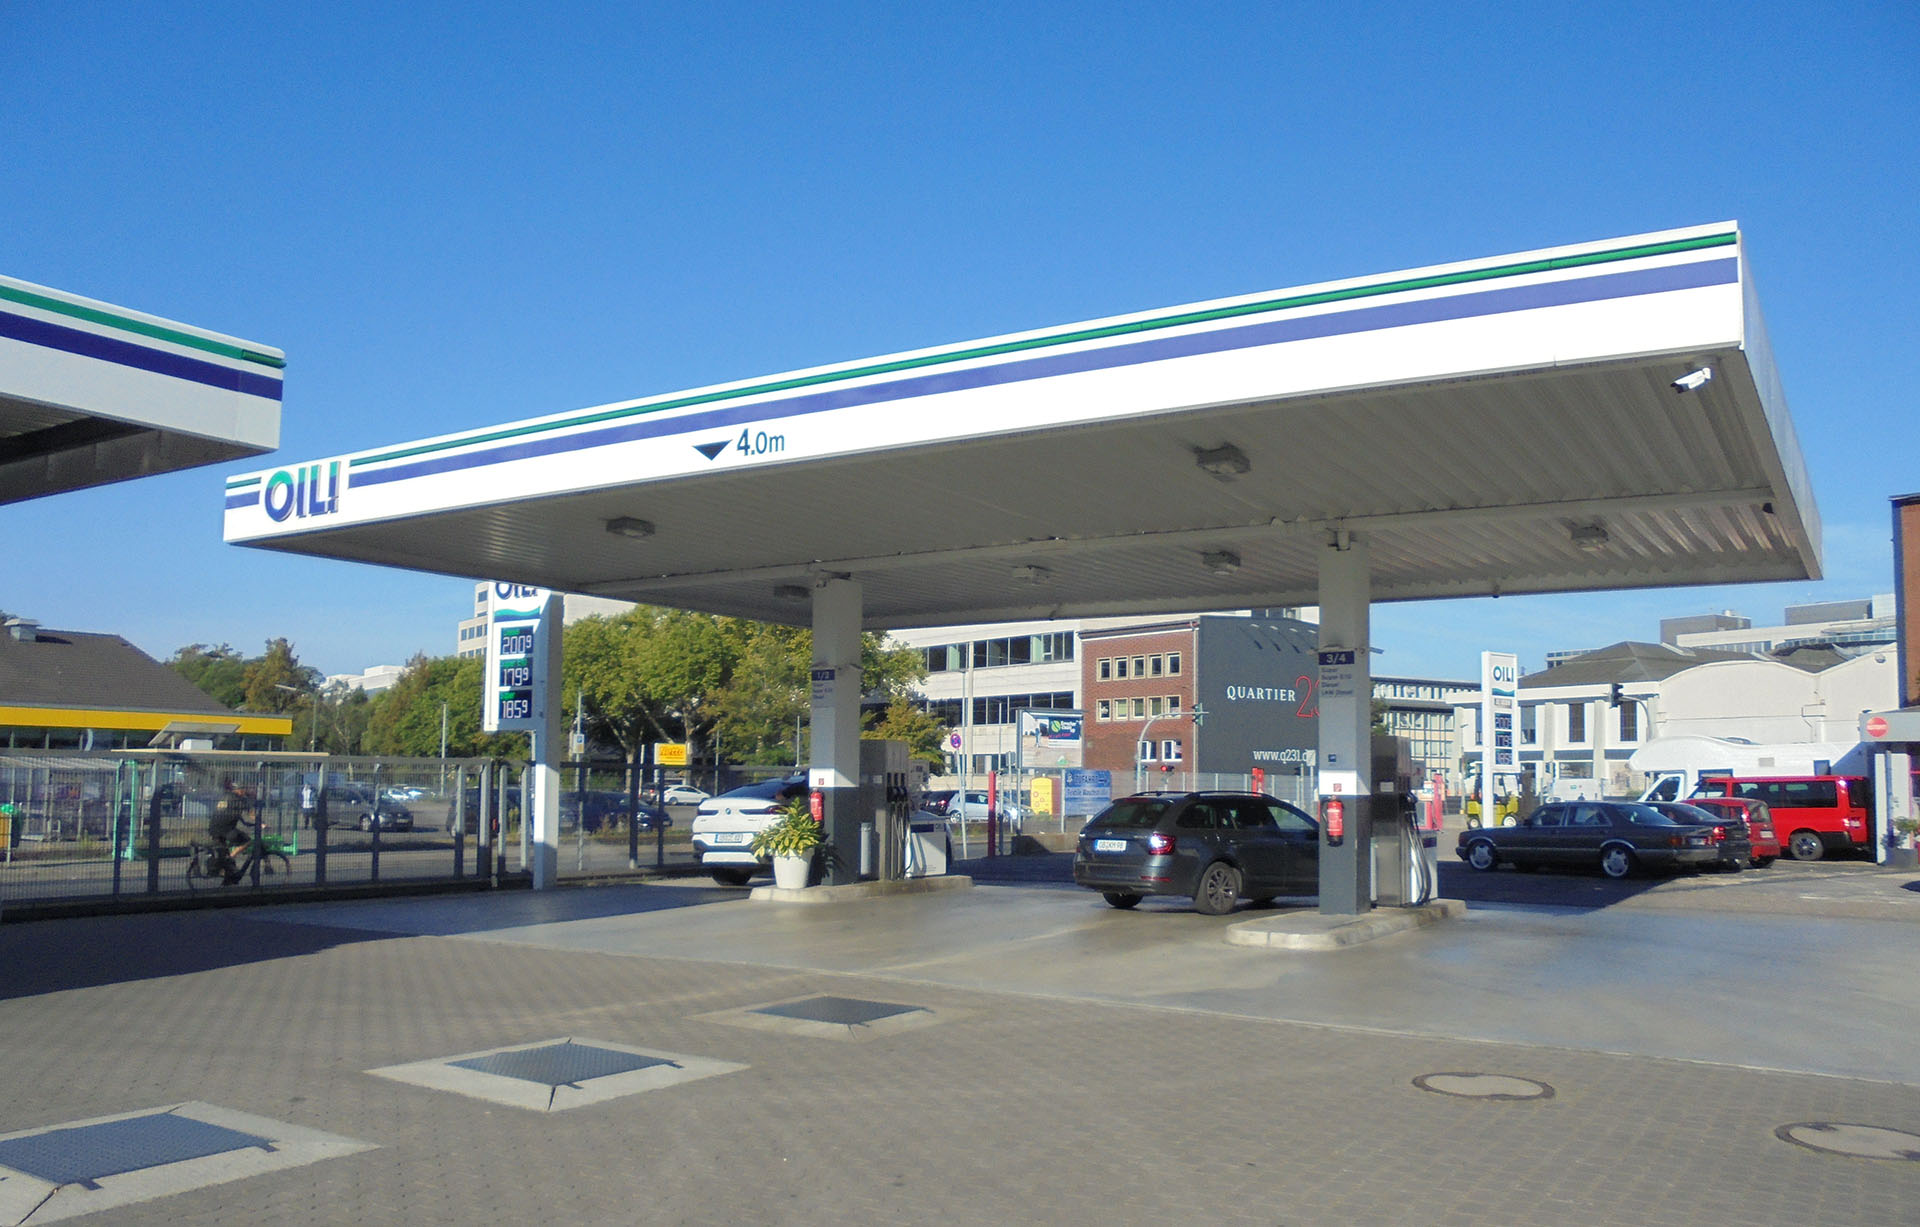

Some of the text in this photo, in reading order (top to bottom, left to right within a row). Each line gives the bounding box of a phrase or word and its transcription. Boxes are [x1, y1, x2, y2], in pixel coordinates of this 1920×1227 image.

[737, 428, 785, 456] 4.0m
[265, 461, 341, 522] OIL!
[502, 634, 532, 655] 2009
[1326, 653, 1347, 663] 3/4
[503, 667, 529, 686] 1799
[1226, 685, 1296, 702] QUARTIER
[502, 700, 528, 719] 1859
